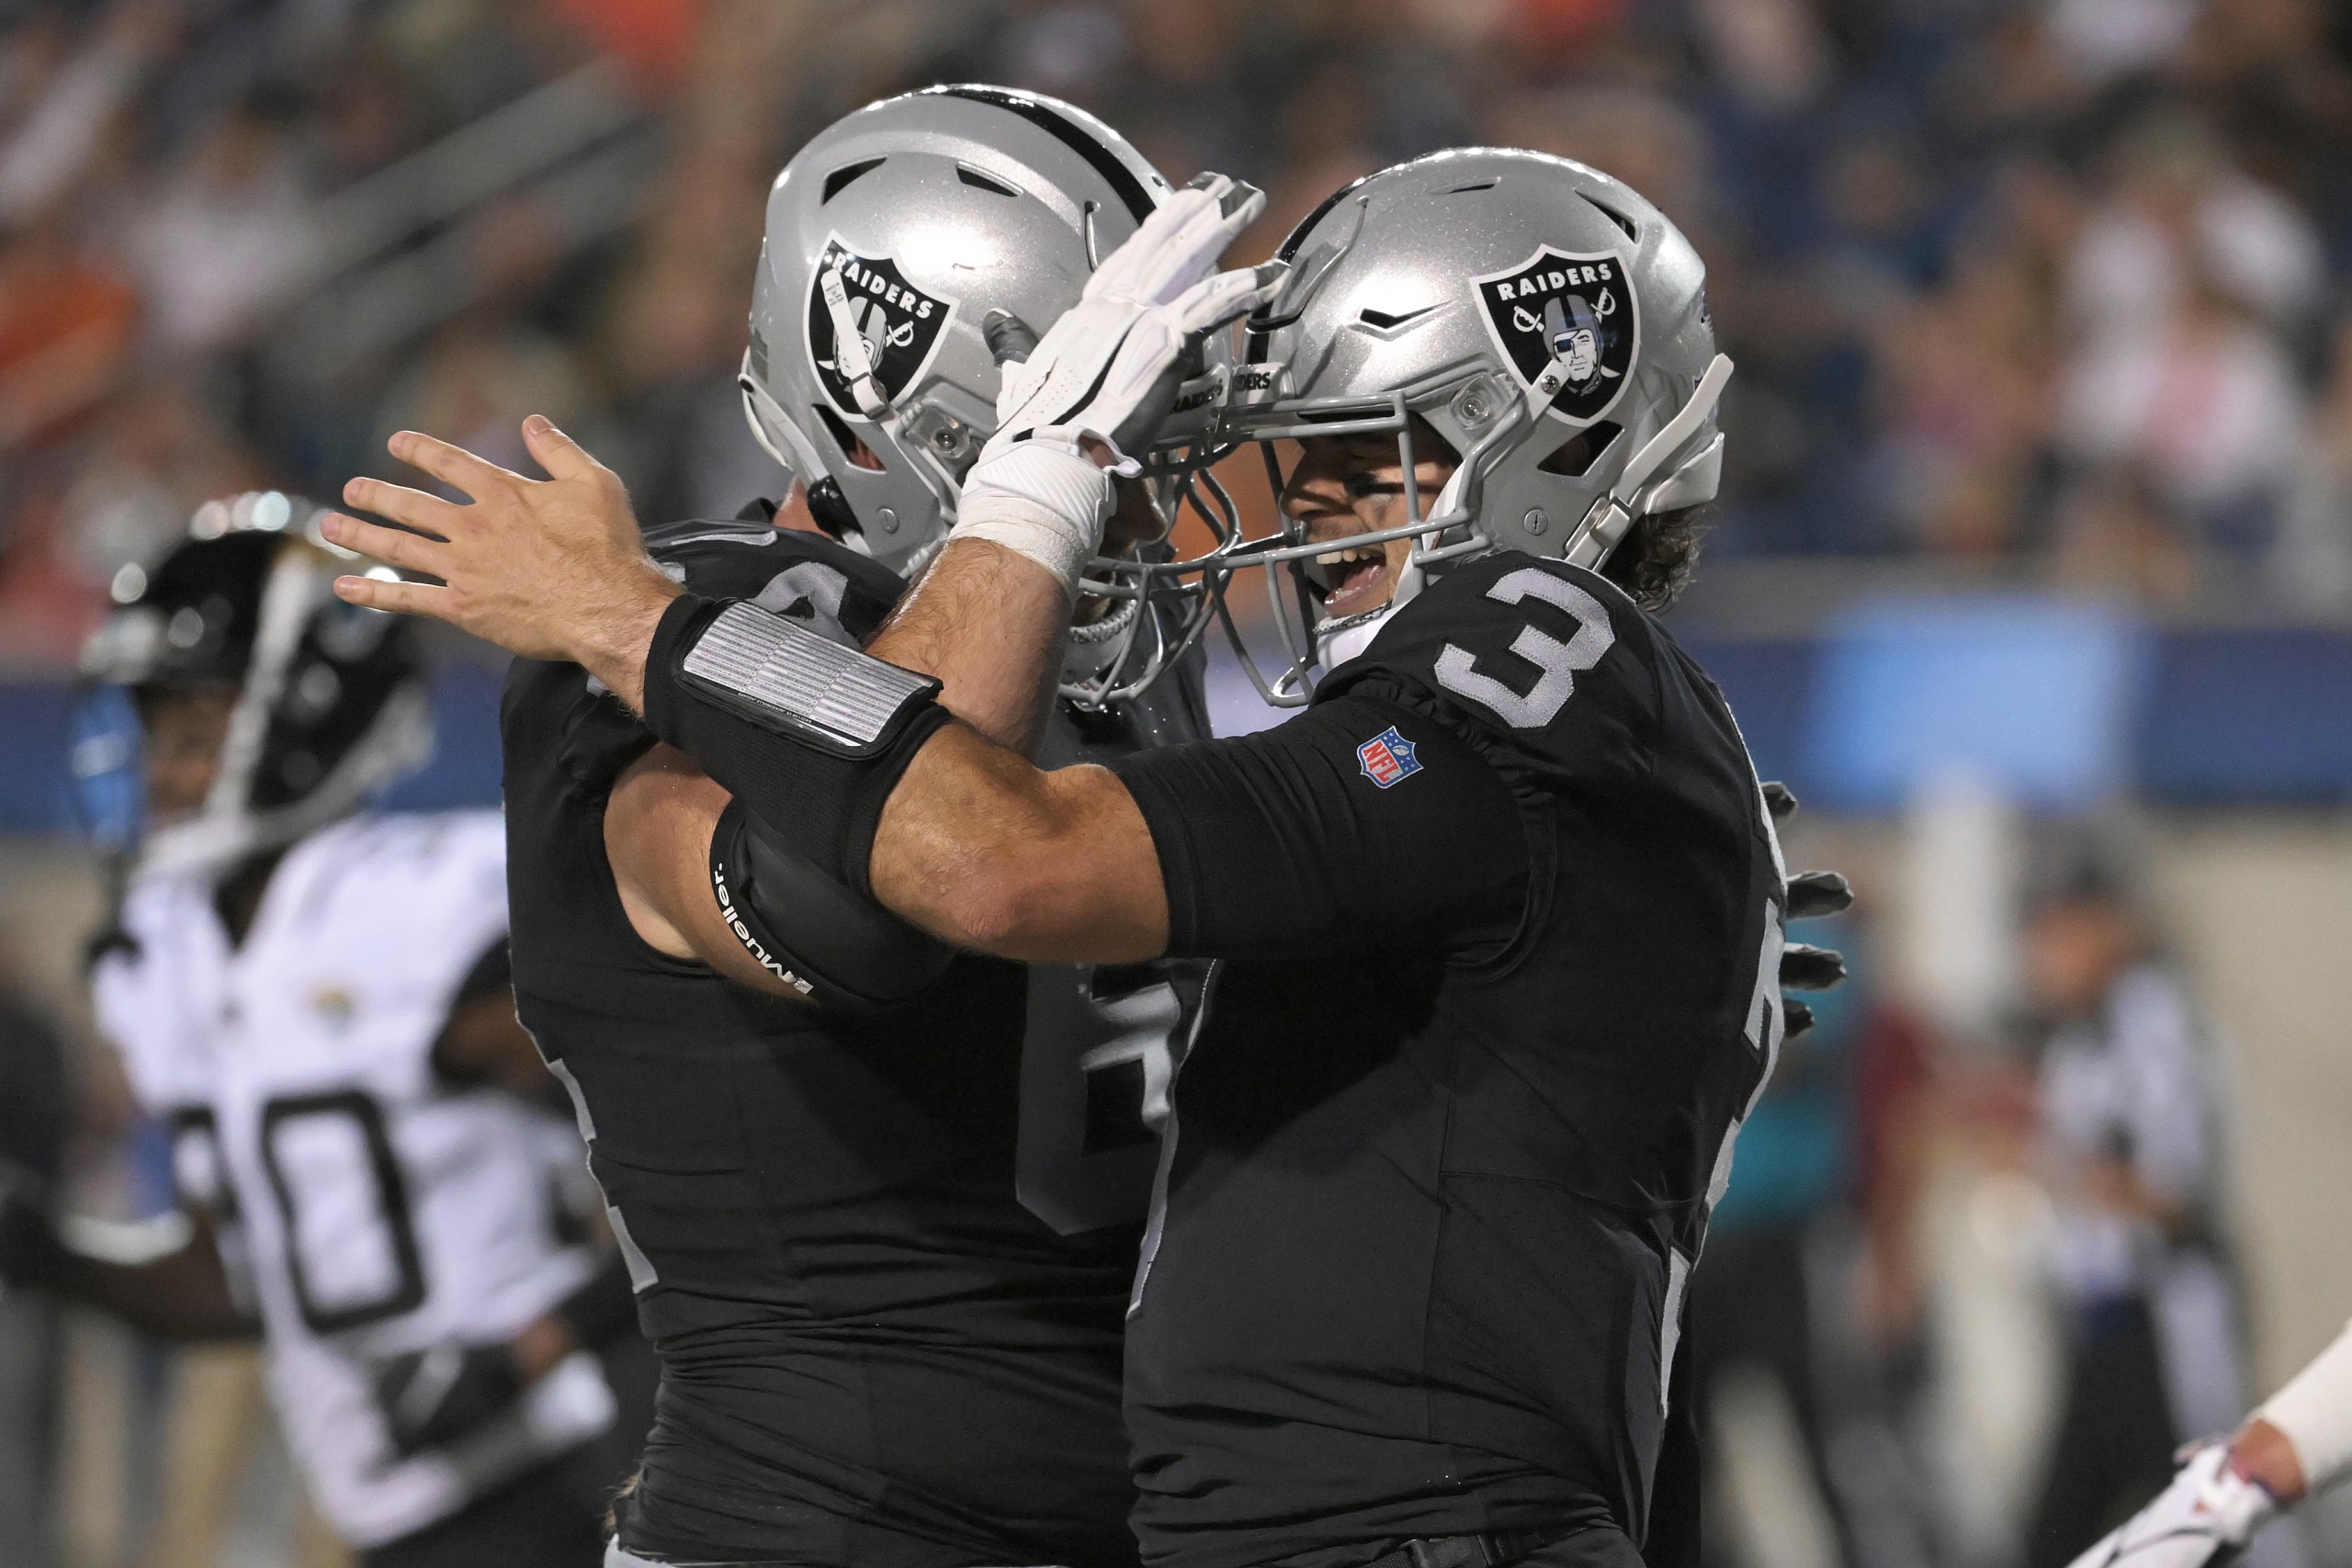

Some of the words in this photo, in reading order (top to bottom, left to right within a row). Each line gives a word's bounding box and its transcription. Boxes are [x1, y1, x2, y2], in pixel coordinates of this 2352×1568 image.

[832, 251, 933, 319] RAIDERS
[1497, 263, 1612, 301] RAIDERS
[1433, 568, 1616, 728] 3
[1363, 739, 1399, 784] NFL
